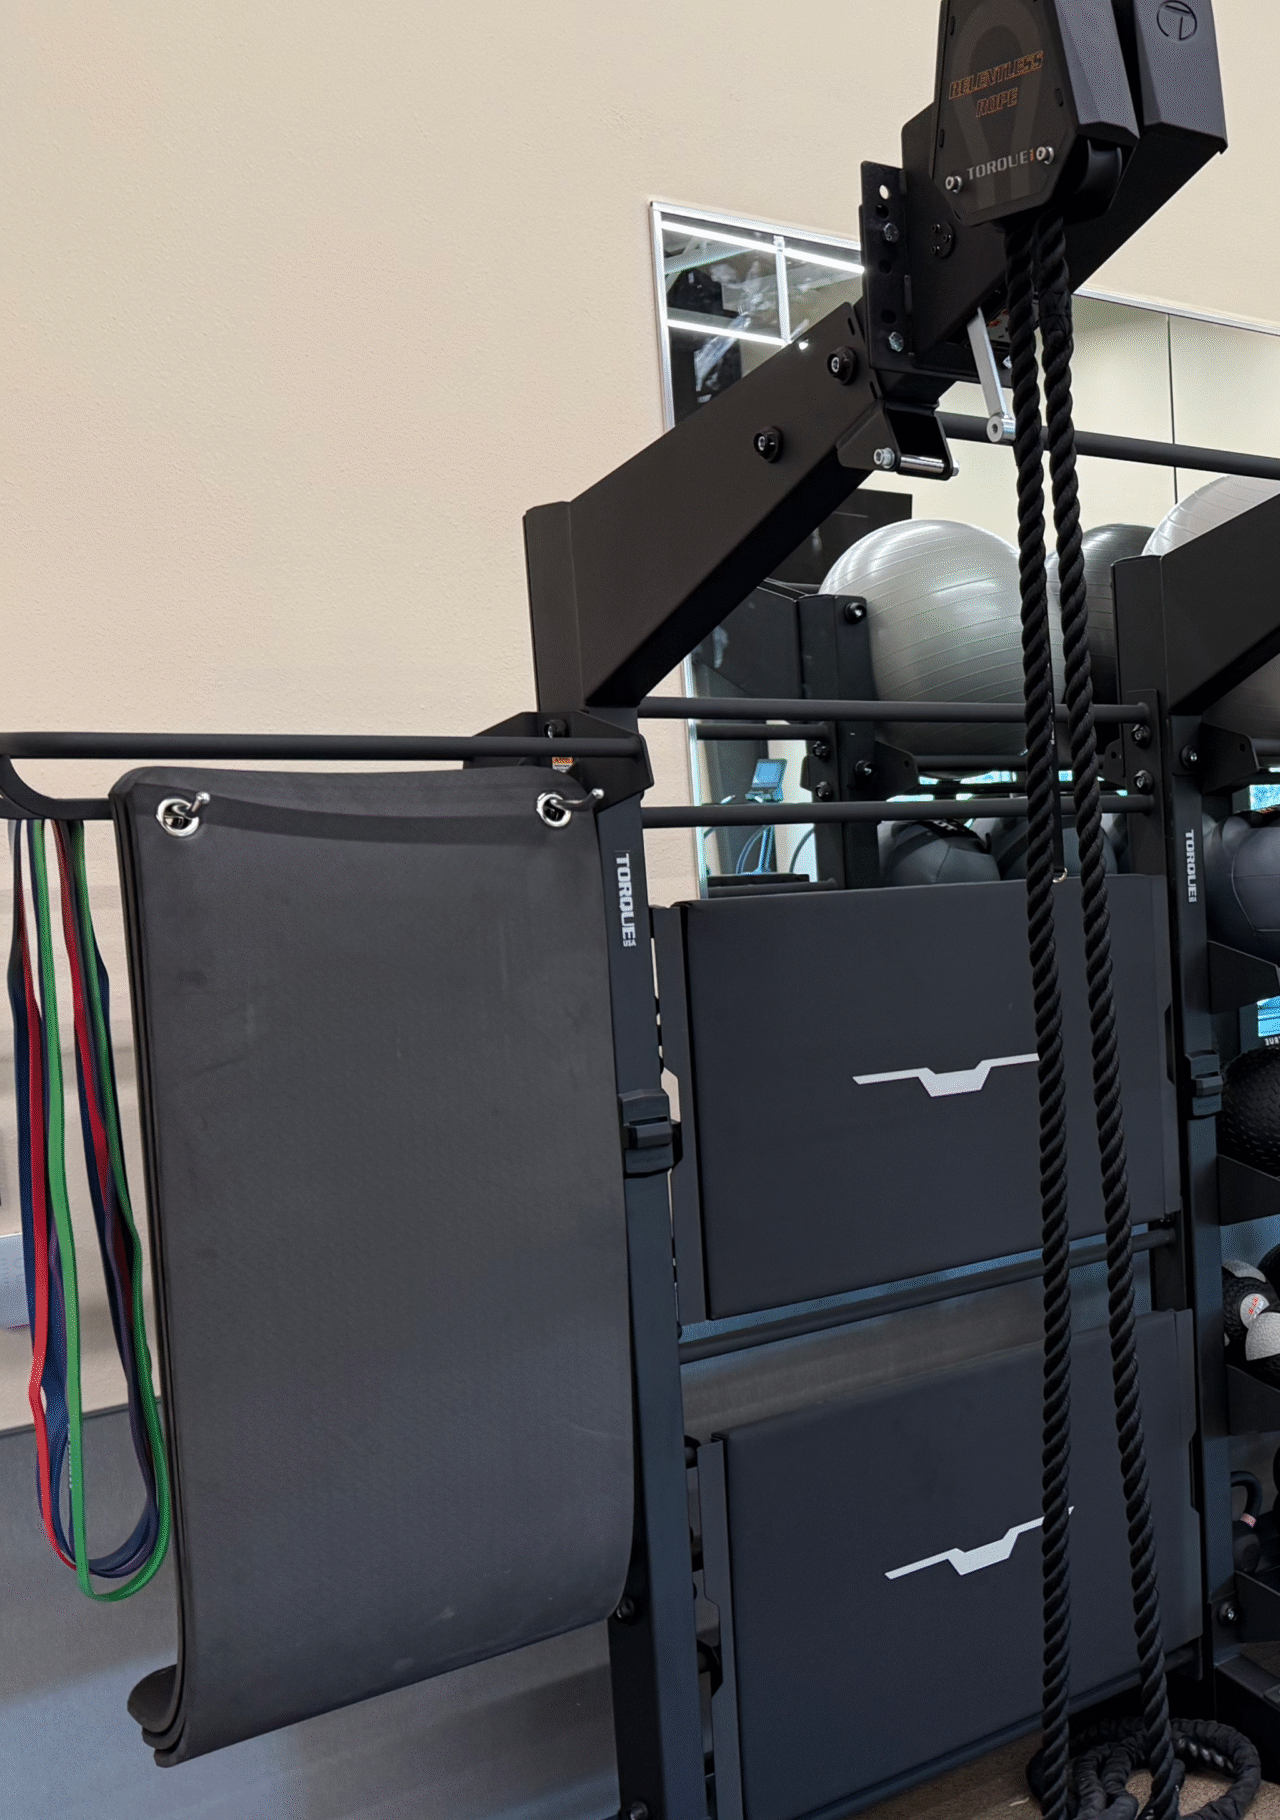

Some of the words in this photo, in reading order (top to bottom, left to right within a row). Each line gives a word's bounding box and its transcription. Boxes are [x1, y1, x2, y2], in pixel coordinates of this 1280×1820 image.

[949, 50, 1043, 99] RELENTLESS
[976, 87, 1018, 117] ROPE
[967, 150, 1029, 180] TORQUE
[1185, 829, 1197, 896] TORQUE
[616, 853, 636, 939] TORQUE
